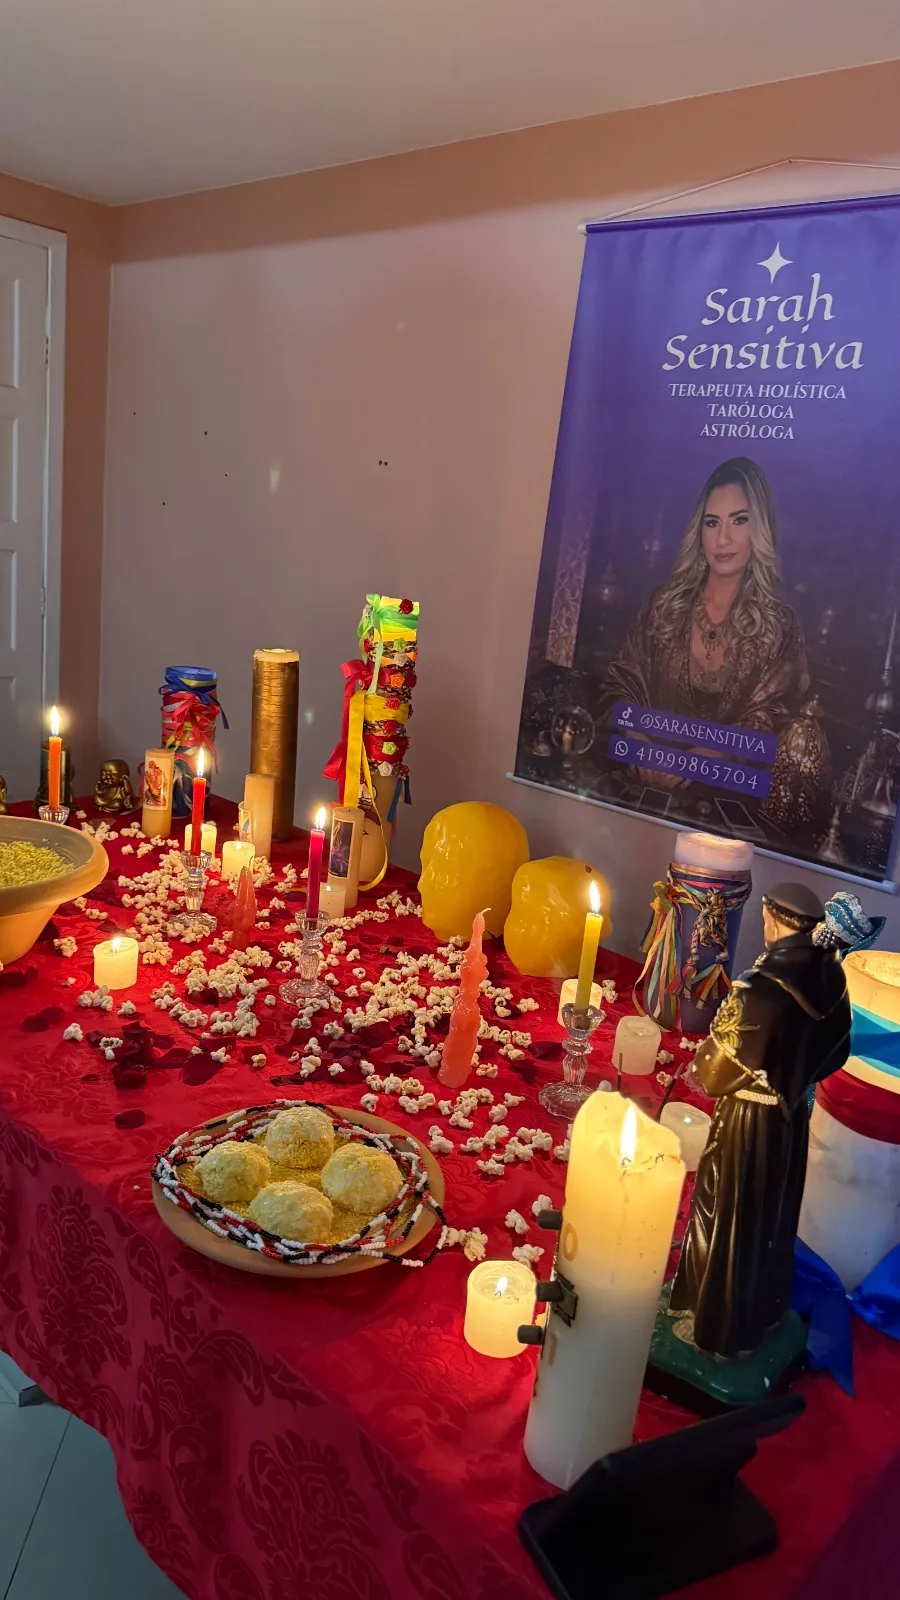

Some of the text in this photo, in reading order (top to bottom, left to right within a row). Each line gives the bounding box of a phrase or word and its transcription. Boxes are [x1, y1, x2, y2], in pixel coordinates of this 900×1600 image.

[701, 272, 836, 326] Sarah
[661, 323, 866, 371] Sensitiva
[669, 381, 847, 400] TERAPEUTA HOLÍSTICA
[707, 401, 794, 419] TARÓLOGA
[700, 422, 794, 440] ASTRÓLOGA
[640, 713, 766, 754] @SARASENSITIVA
[636, 746, 758, 790] 41999865704
